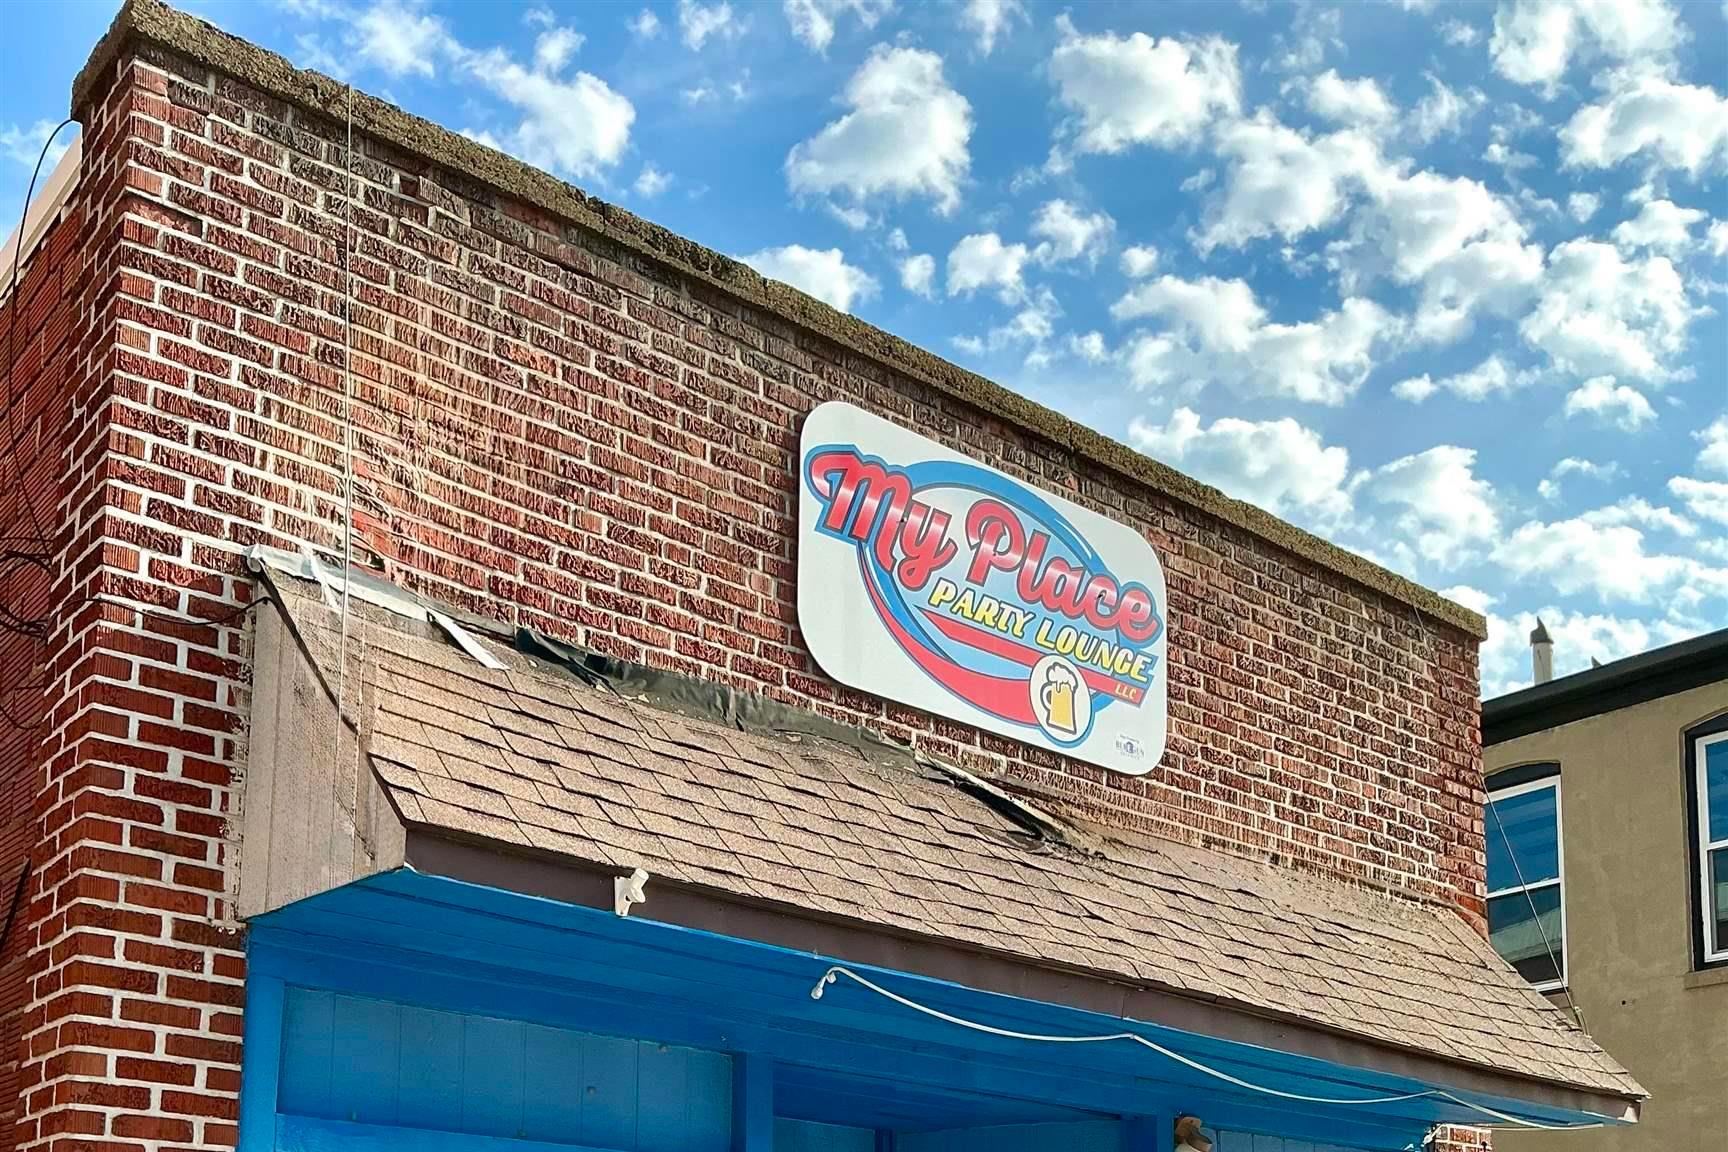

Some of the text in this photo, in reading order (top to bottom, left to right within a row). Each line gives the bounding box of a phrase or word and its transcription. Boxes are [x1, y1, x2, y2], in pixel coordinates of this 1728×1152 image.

[808, 450, 1158, 642] My Place
[928, 580, 1154, 683] PARTY LOUNGE
[1115, 683, 1137, 700] LLC
